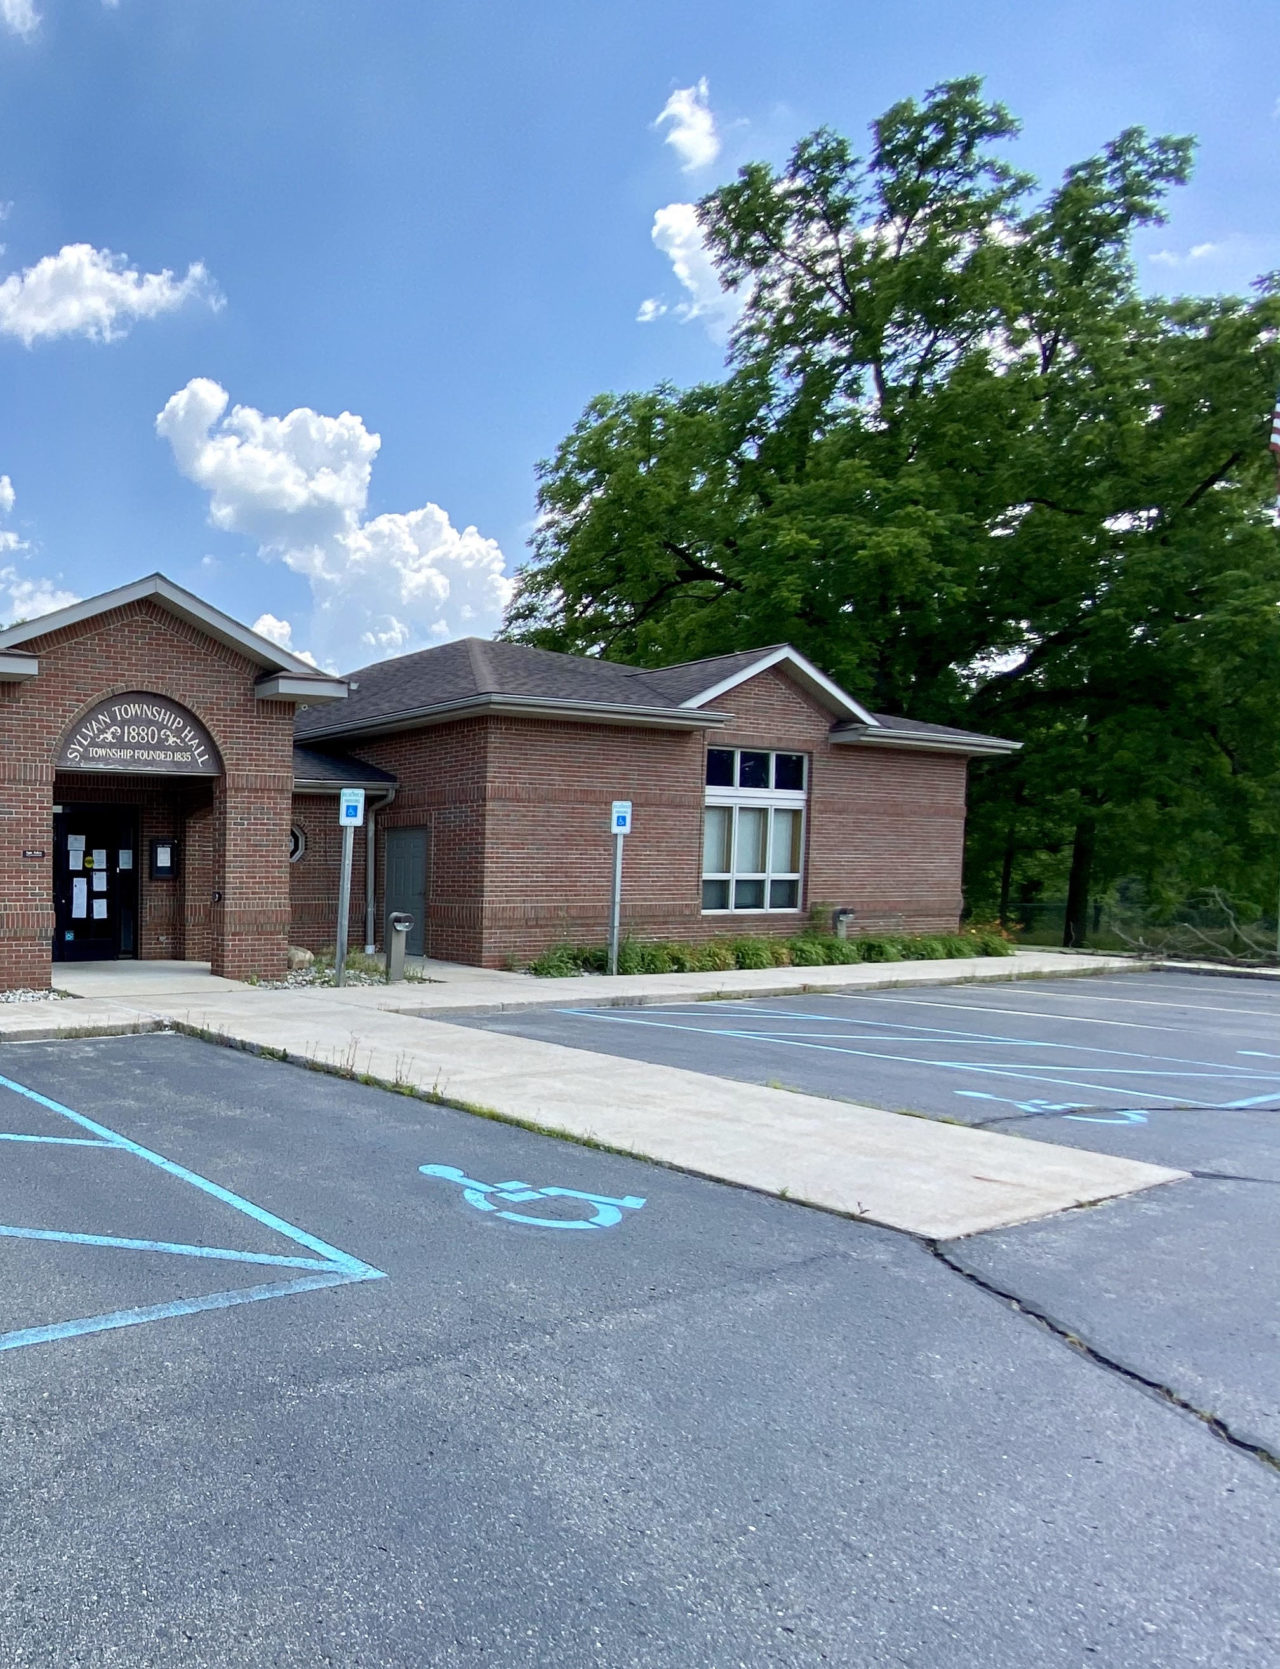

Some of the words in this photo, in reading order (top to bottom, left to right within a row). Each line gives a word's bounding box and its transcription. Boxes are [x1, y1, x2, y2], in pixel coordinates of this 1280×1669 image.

[67, 712, 111, 761] SYLVAN
[112, 703, 183, 729] TOWNSHIP
[181, 726, 209, 767] HALL
[124, 725, 158, 744] 1880
[89, 747, 133, 760] TOWNSHIP
[134, 749, 173, 762] FOUNDED
[174, 752, 191, 762] 1835
